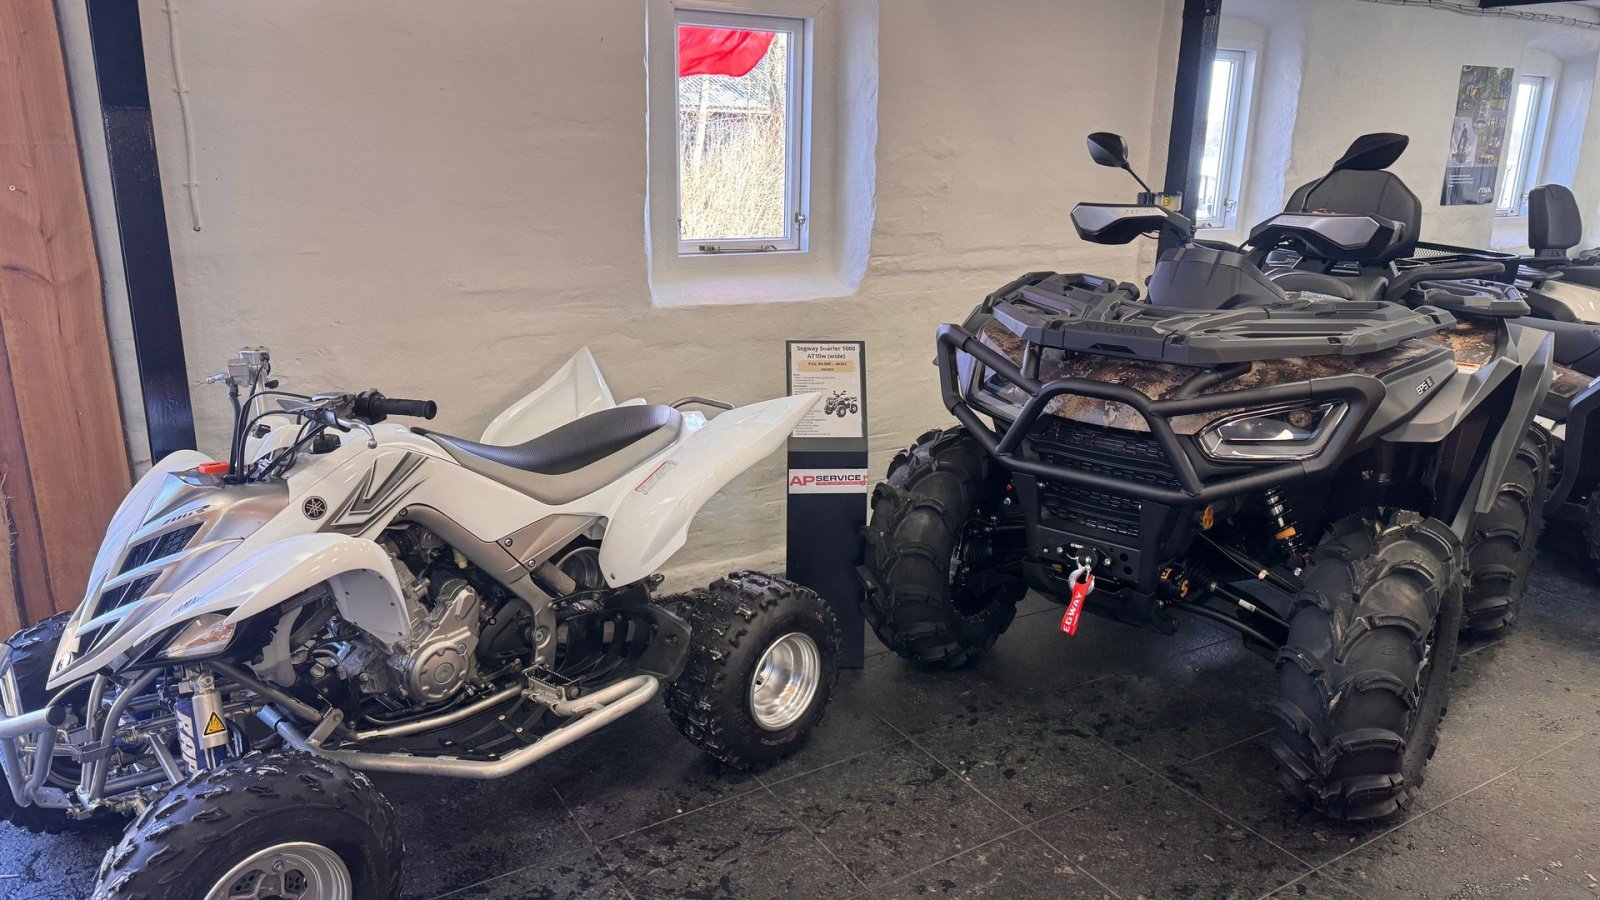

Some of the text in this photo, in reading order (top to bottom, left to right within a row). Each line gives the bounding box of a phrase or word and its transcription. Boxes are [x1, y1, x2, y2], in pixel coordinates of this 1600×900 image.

[1086, 322, 1147, 337] SEGWAY
[1416, 380, 1429, 395] EPS
[790, 475, 815, 486] AP
[815, 474, 861, 482] SERVICE
